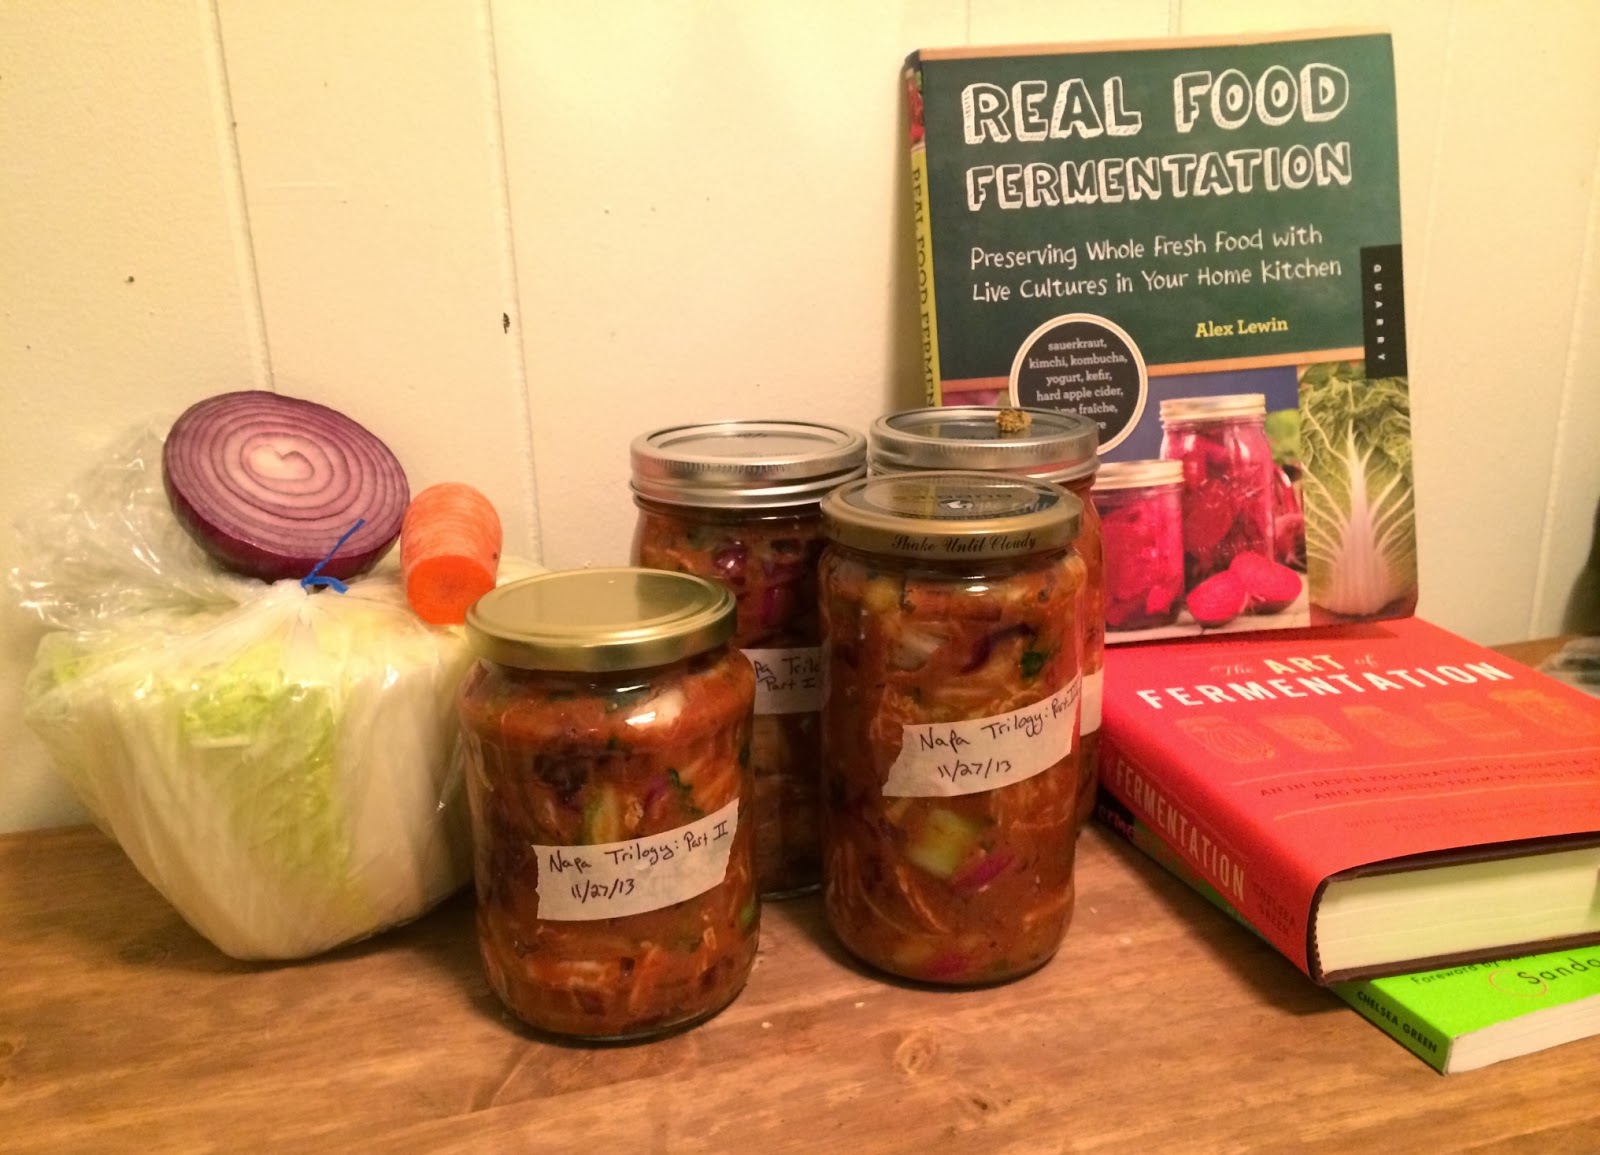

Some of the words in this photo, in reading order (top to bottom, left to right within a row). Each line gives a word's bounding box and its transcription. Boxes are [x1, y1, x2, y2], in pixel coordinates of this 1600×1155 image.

[962, 76, 1142, 144] REAL
[1174, 62, 1350, 133] FOOD
[966, 142, 1352, 212] FERMENTATION
[971, 244, 1077, 270] Preserving
[1086, 238, 1145, 261] Whole
[1154, 233, 1206, 257] Fresh
[1215, 228, 1263, 252] Food
[1272, 223, 1322, 247] with
[917, 236, 928, 305] FOOD
[973, 282, 1011, 302] Live
[1020, 278, 1108, 297] Cultures
[1116, 272, 1133, 293] in
[1141, 270, 1189, 291] Your
[1198, 266, 1252, 286] Home
[1261, 257, 1342, 283] Kitchen
[1195, 320, 1234, 338] Alex
[1237, 317, 1288, 334] Lewin
[1373, 264, 1386, 360] QUARRY
[921, 312, 934, 407] FERMEN
[1029, 356, 1068, 369] kimchi,
[1070, 352, 1128, 366] kombucha,
[1048, 338, 1107, 351] sauerkraut,
[1036, 389, 1061, 401] hard
[1063, 387, 1092, 401] apple
[1094, 385, 1124, 397] cider,
[1046, 373, 1084, 386] yogurt,
[1086, 369, 1113, 381] kefir,
[891, 534, 936, 552] Shake
[944, 535, 987, 552] Until
[989, 532, 1037, 549] Cloudy
[1264, 655, 1345, 674] ART
[759, 676, 797, 692] Part
[1136, 661, 1514, 709] FERMENTATION
[920, 727, 970, 753] Napa
[980, 706, 1049, 738] Trilogy:
[937, 758, 1012, 782] 11/27/13
[549, 850, 592, 873] Napa
[604, 840, 679, 866] Trilogy:
[684, 831, 708, 852] Part
[713, 820, 729, 841] II
[1116, 758, 1247, 902] FERMENTATION
[571, 878, 635, 904] 11/27/13
[1411, 965, 1478, 985] Foreword
[1517, 957, 1600, 984] Sando
[1357, 991, 1398, 1027] CHELSEA
[1402, 1022, 1438, 1053] GREEN
